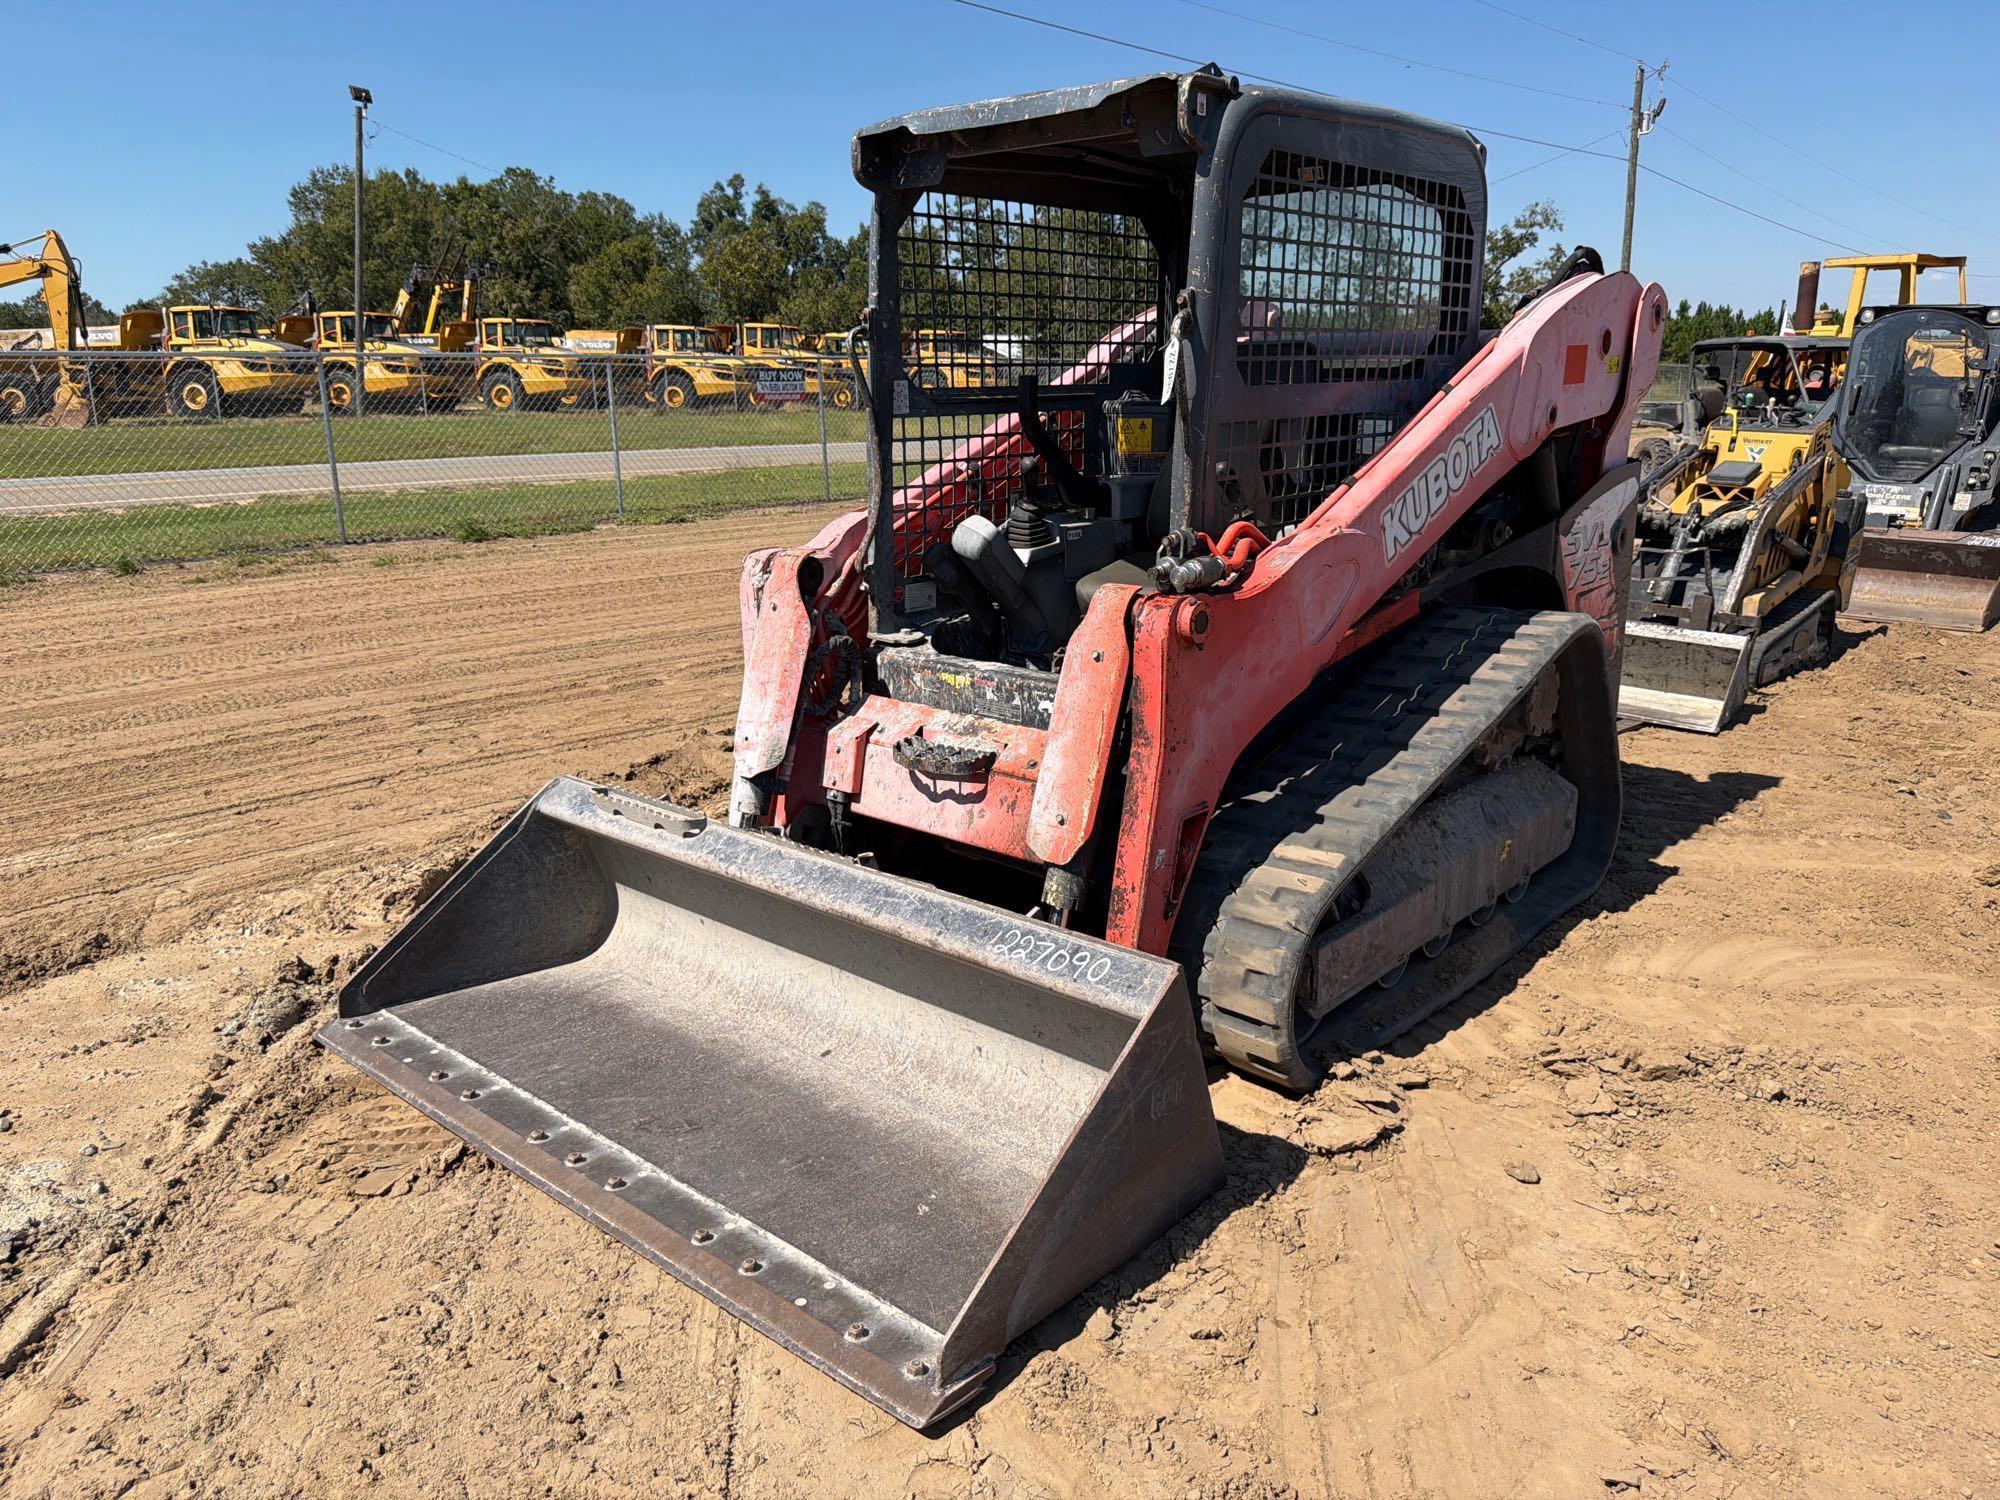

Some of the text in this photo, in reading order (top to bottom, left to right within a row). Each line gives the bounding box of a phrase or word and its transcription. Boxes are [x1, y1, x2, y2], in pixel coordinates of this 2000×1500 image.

[759, 371, 803, 380] BUY NOW
[1743, 437, 1773, 445] Vermeer
[1382, 404, 1503, 562] KUBOTA
[1885, 493, 1913, 501] DEERE
[1564, 520, 1609, 558] SVL
[994, 929, 1111, 982] 227090
